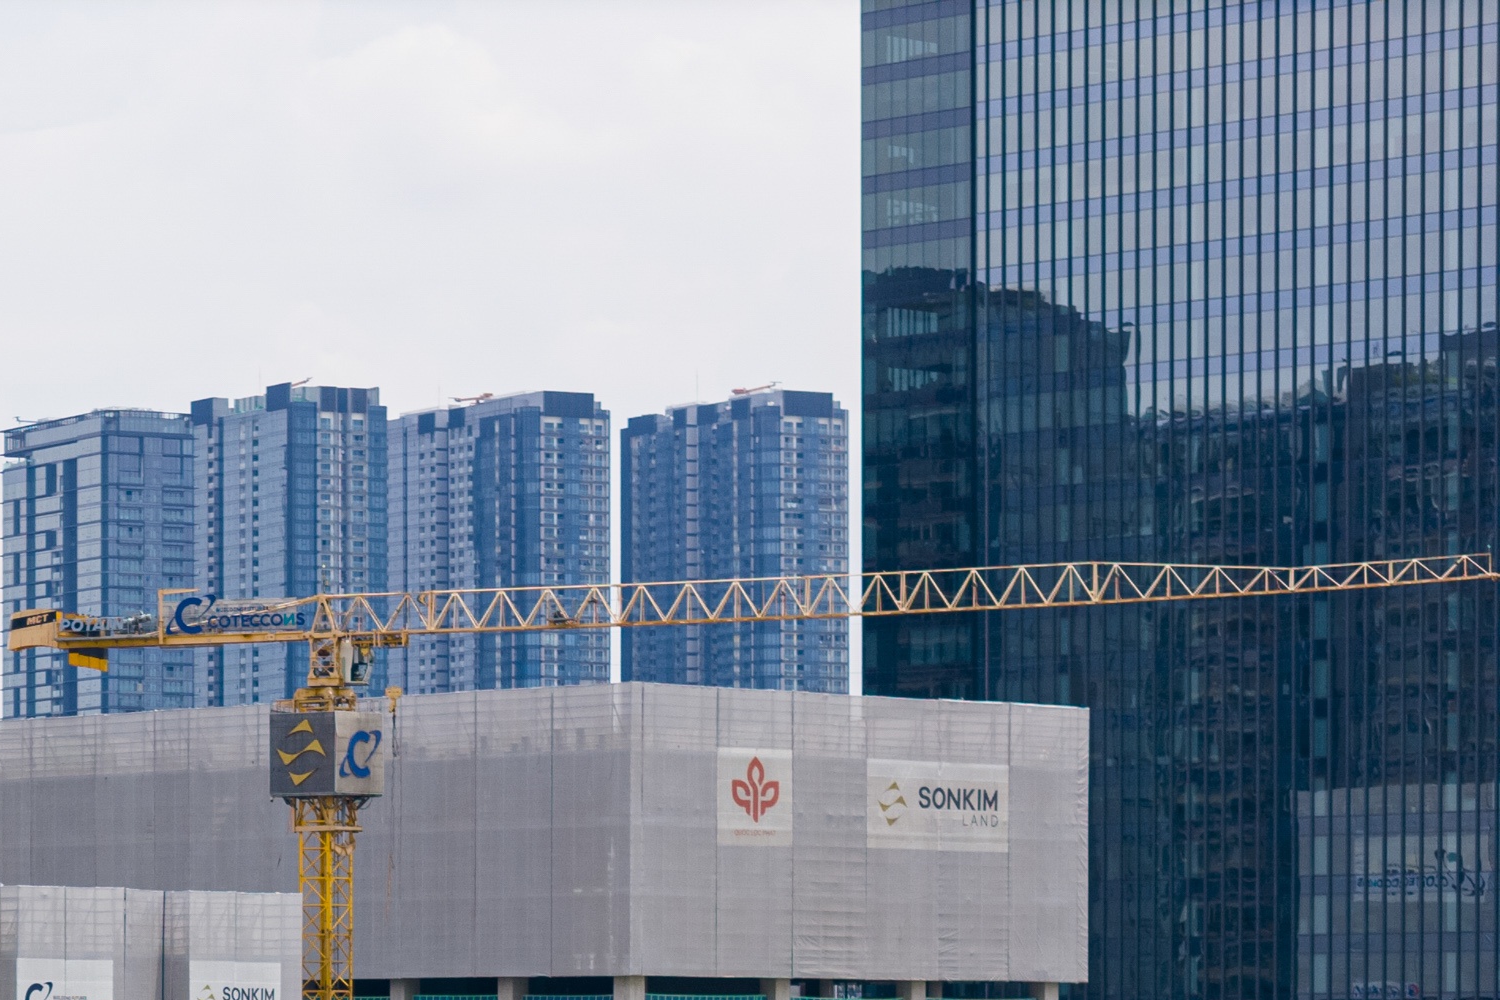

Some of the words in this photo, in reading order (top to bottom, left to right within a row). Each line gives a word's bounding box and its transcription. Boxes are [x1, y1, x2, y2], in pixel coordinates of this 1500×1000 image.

[26, 613, 49, 626] MCT
[60, 616, 124, 632] POTAIN
[919, 786, 998, 811] SONKIM
[962, 814, 999, 828] LAND
